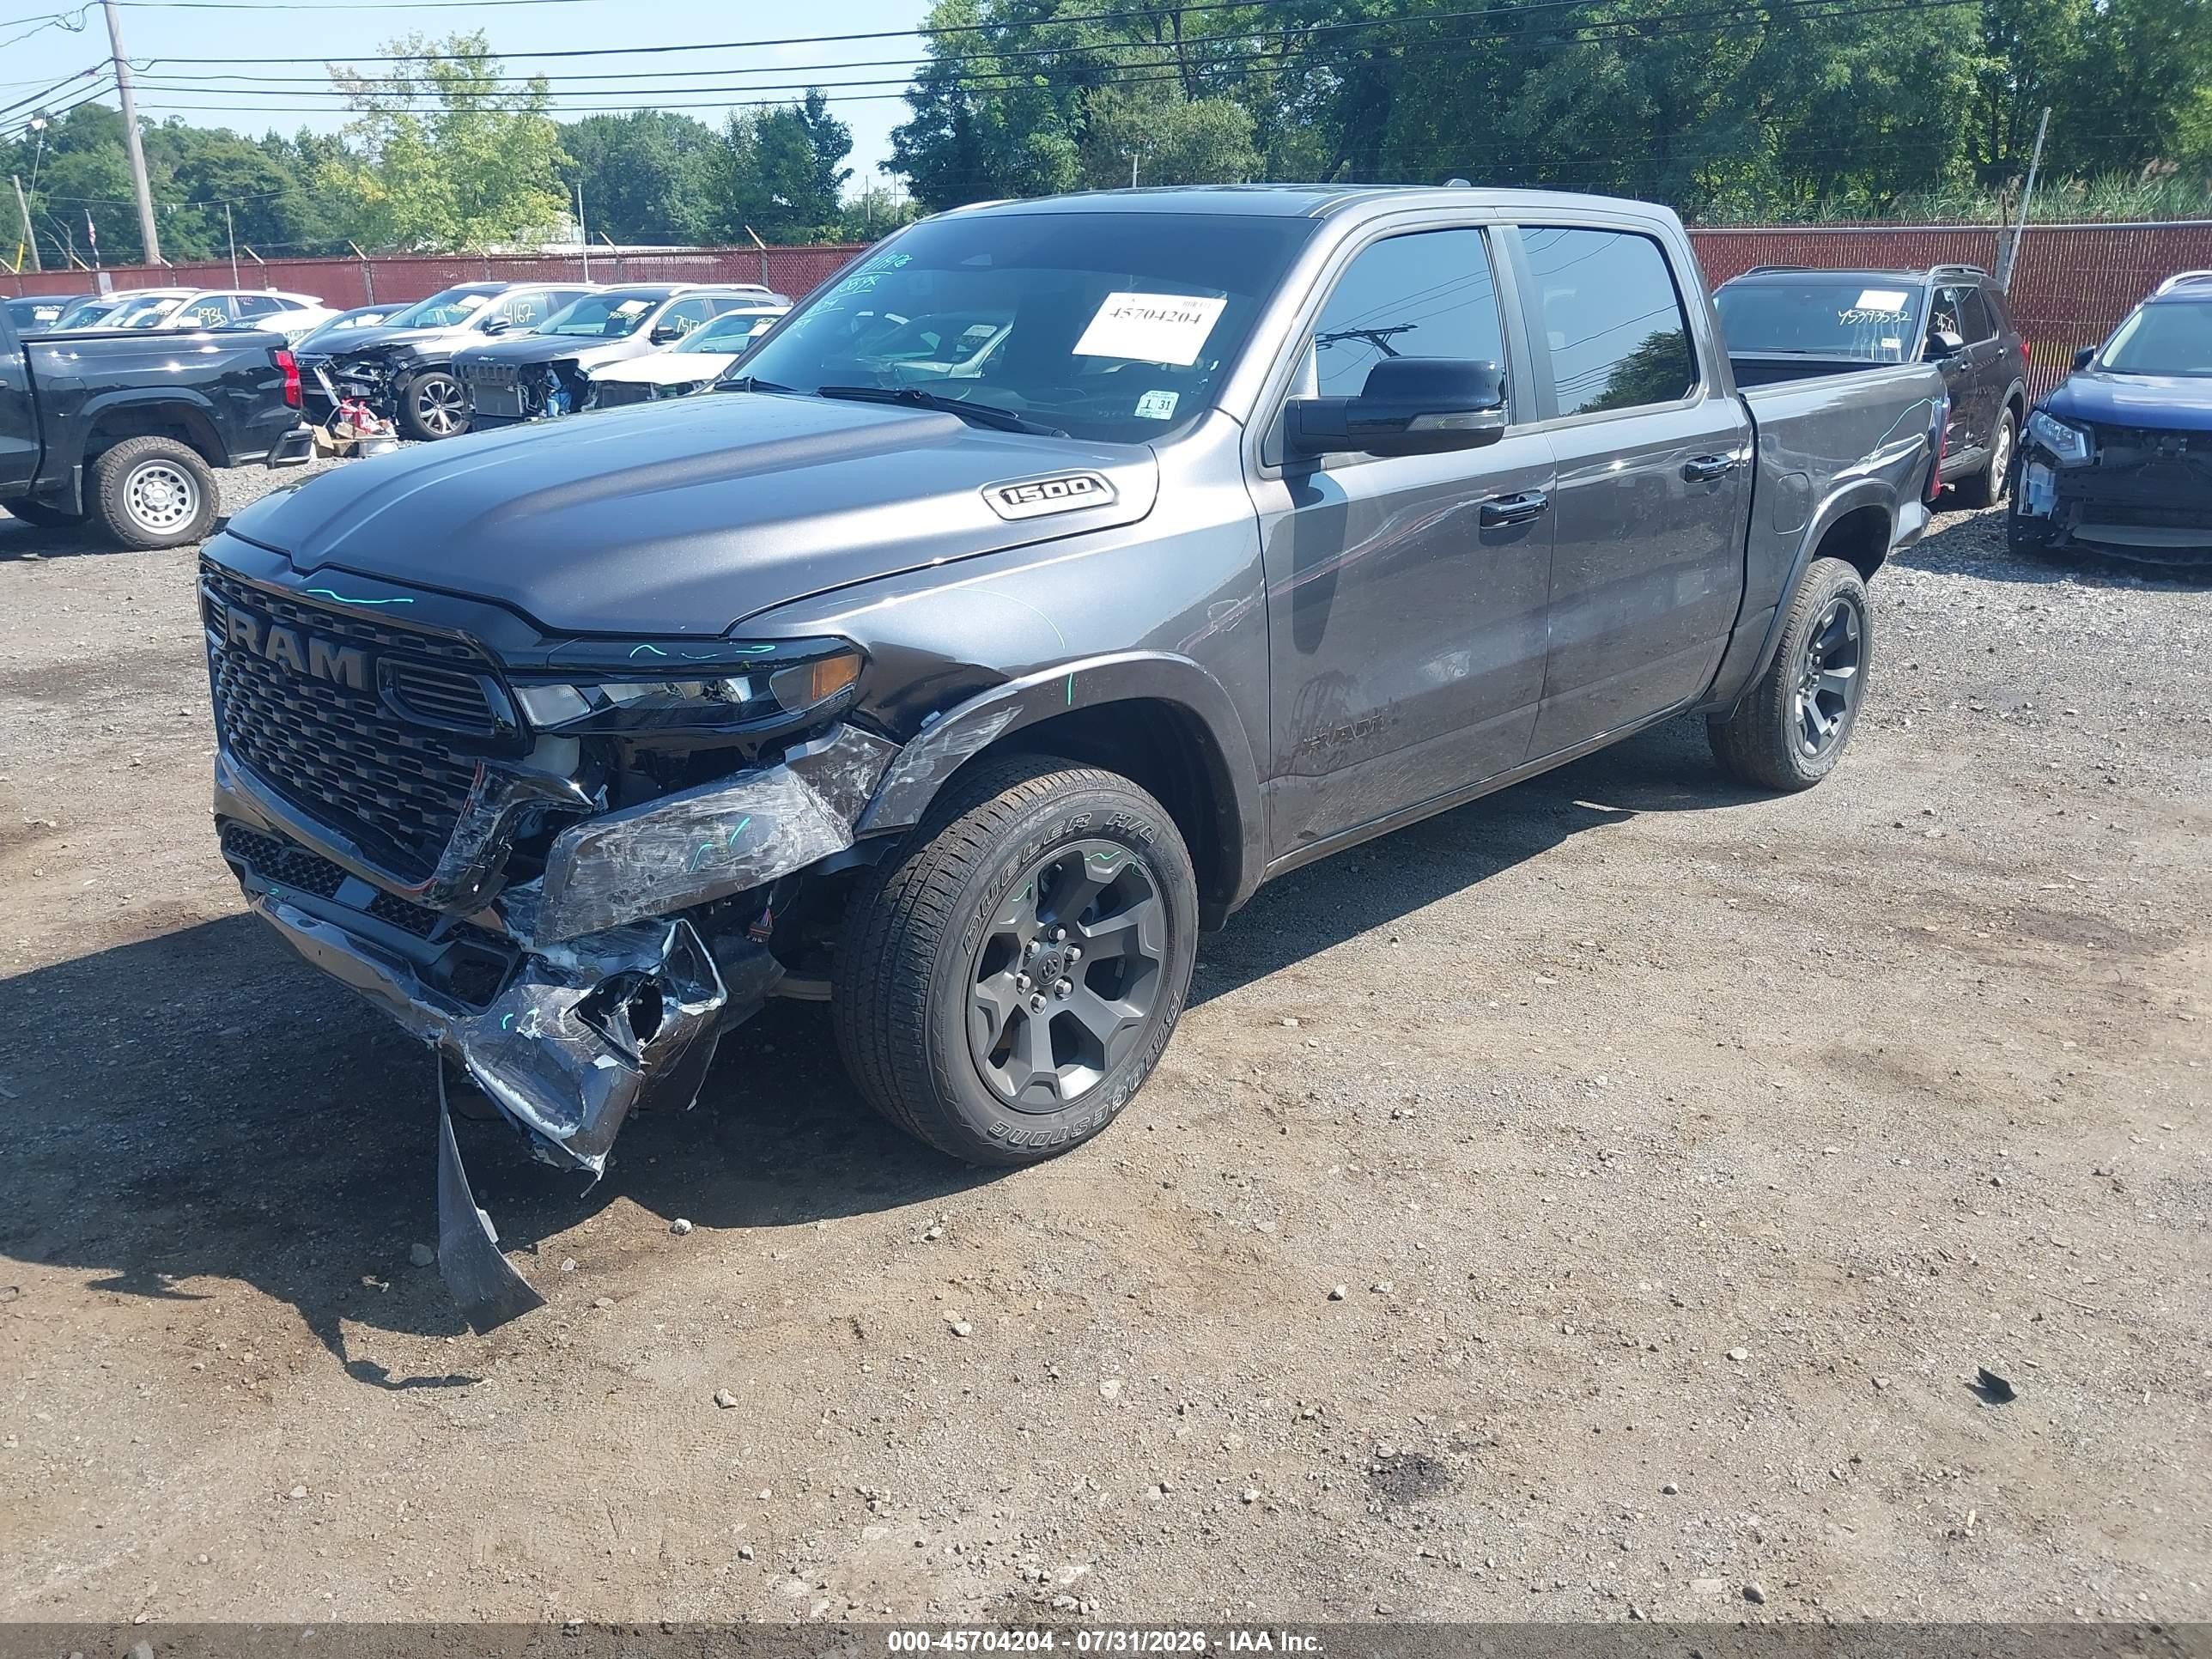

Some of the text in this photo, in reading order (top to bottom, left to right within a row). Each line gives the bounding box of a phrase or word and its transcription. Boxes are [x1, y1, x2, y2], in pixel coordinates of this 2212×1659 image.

[503, 302, 536, 323] 4167
[1109, 307, 1202, 324] 45704204
[1158, 400, 1171, 410] 31
[1002, 477, 1092, 505] 1500
[228, 605, 369, 691] RAM
[963, 811, 1092, 956] DUELER
[1106, 812, 1155, 844] H/L
[989, 990, 1181, 1147] BRIDGESTONE
